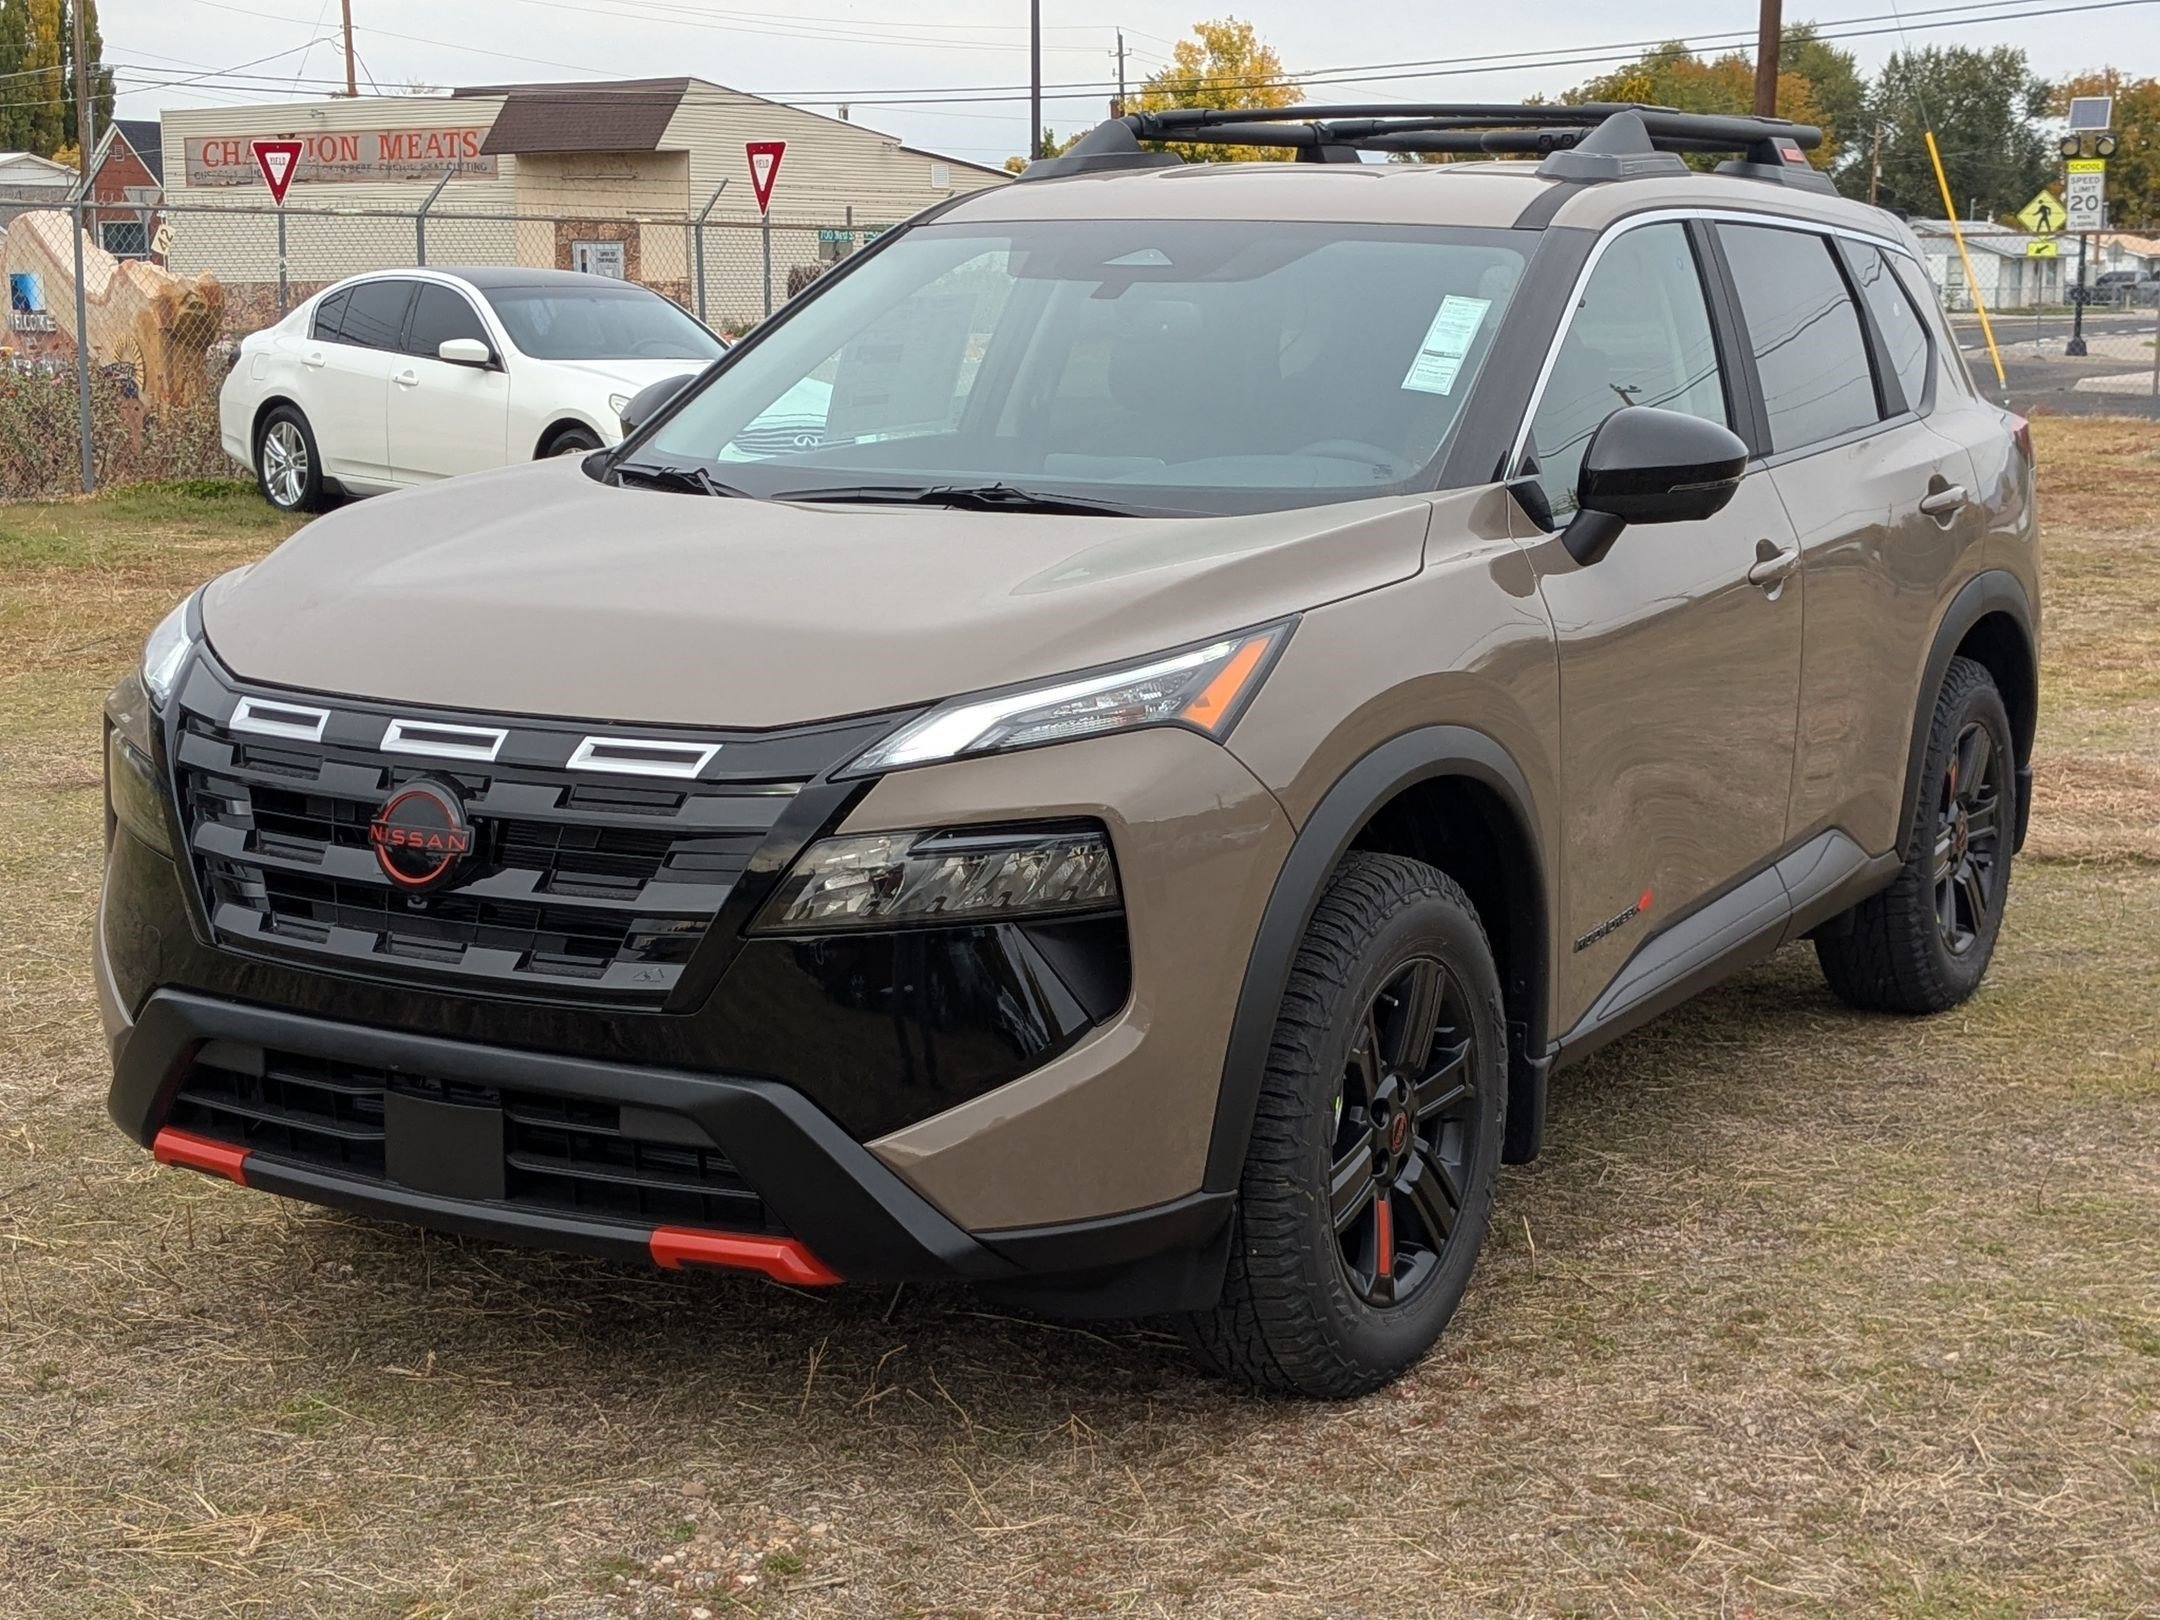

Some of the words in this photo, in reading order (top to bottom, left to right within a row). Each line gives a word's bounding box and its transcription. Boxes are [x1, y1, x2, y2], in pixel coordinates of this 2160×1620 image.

[202, 135, 360, 167] CHAION
[378, 131, 479, 160] MEATS
[270, 157, 285, 165] YIELD
[2070, 176, 2100, 184] SPEED
[2073, 185, 2097, 193] LIMIT
[2069, 195, 2099, 211] 20
[820, 230, 834, 240] 700
[370, 824, 467, 850] NISSAN
